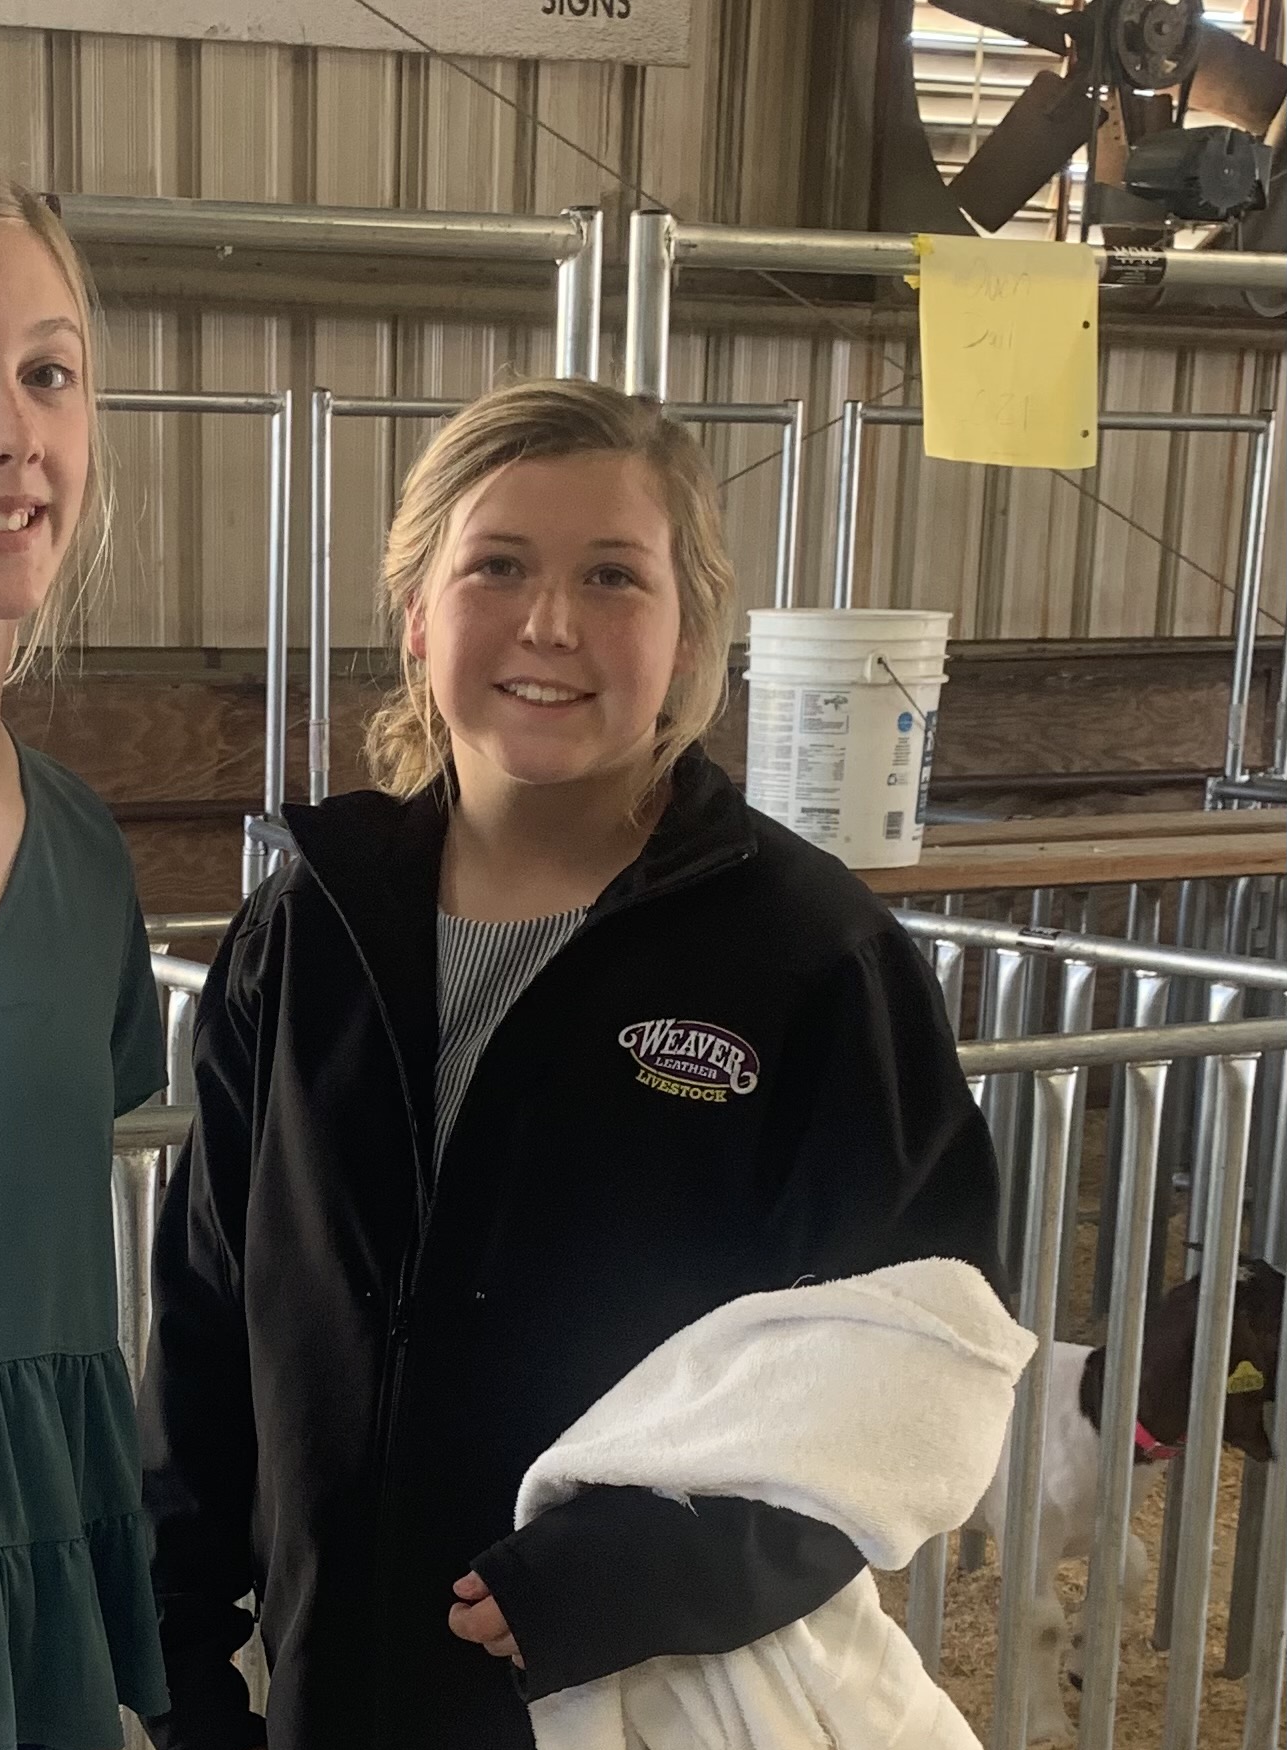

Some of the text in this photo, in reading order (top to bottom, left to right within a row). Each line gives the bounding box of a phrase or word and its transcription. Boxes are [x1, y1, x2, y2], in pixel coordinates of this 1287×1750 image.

[620, 1018, 757, 1094] WEAVER
[654, 1057, 717, 1080] LEATHER
[635, 1069, 728, 1103] LIVESTOCK
